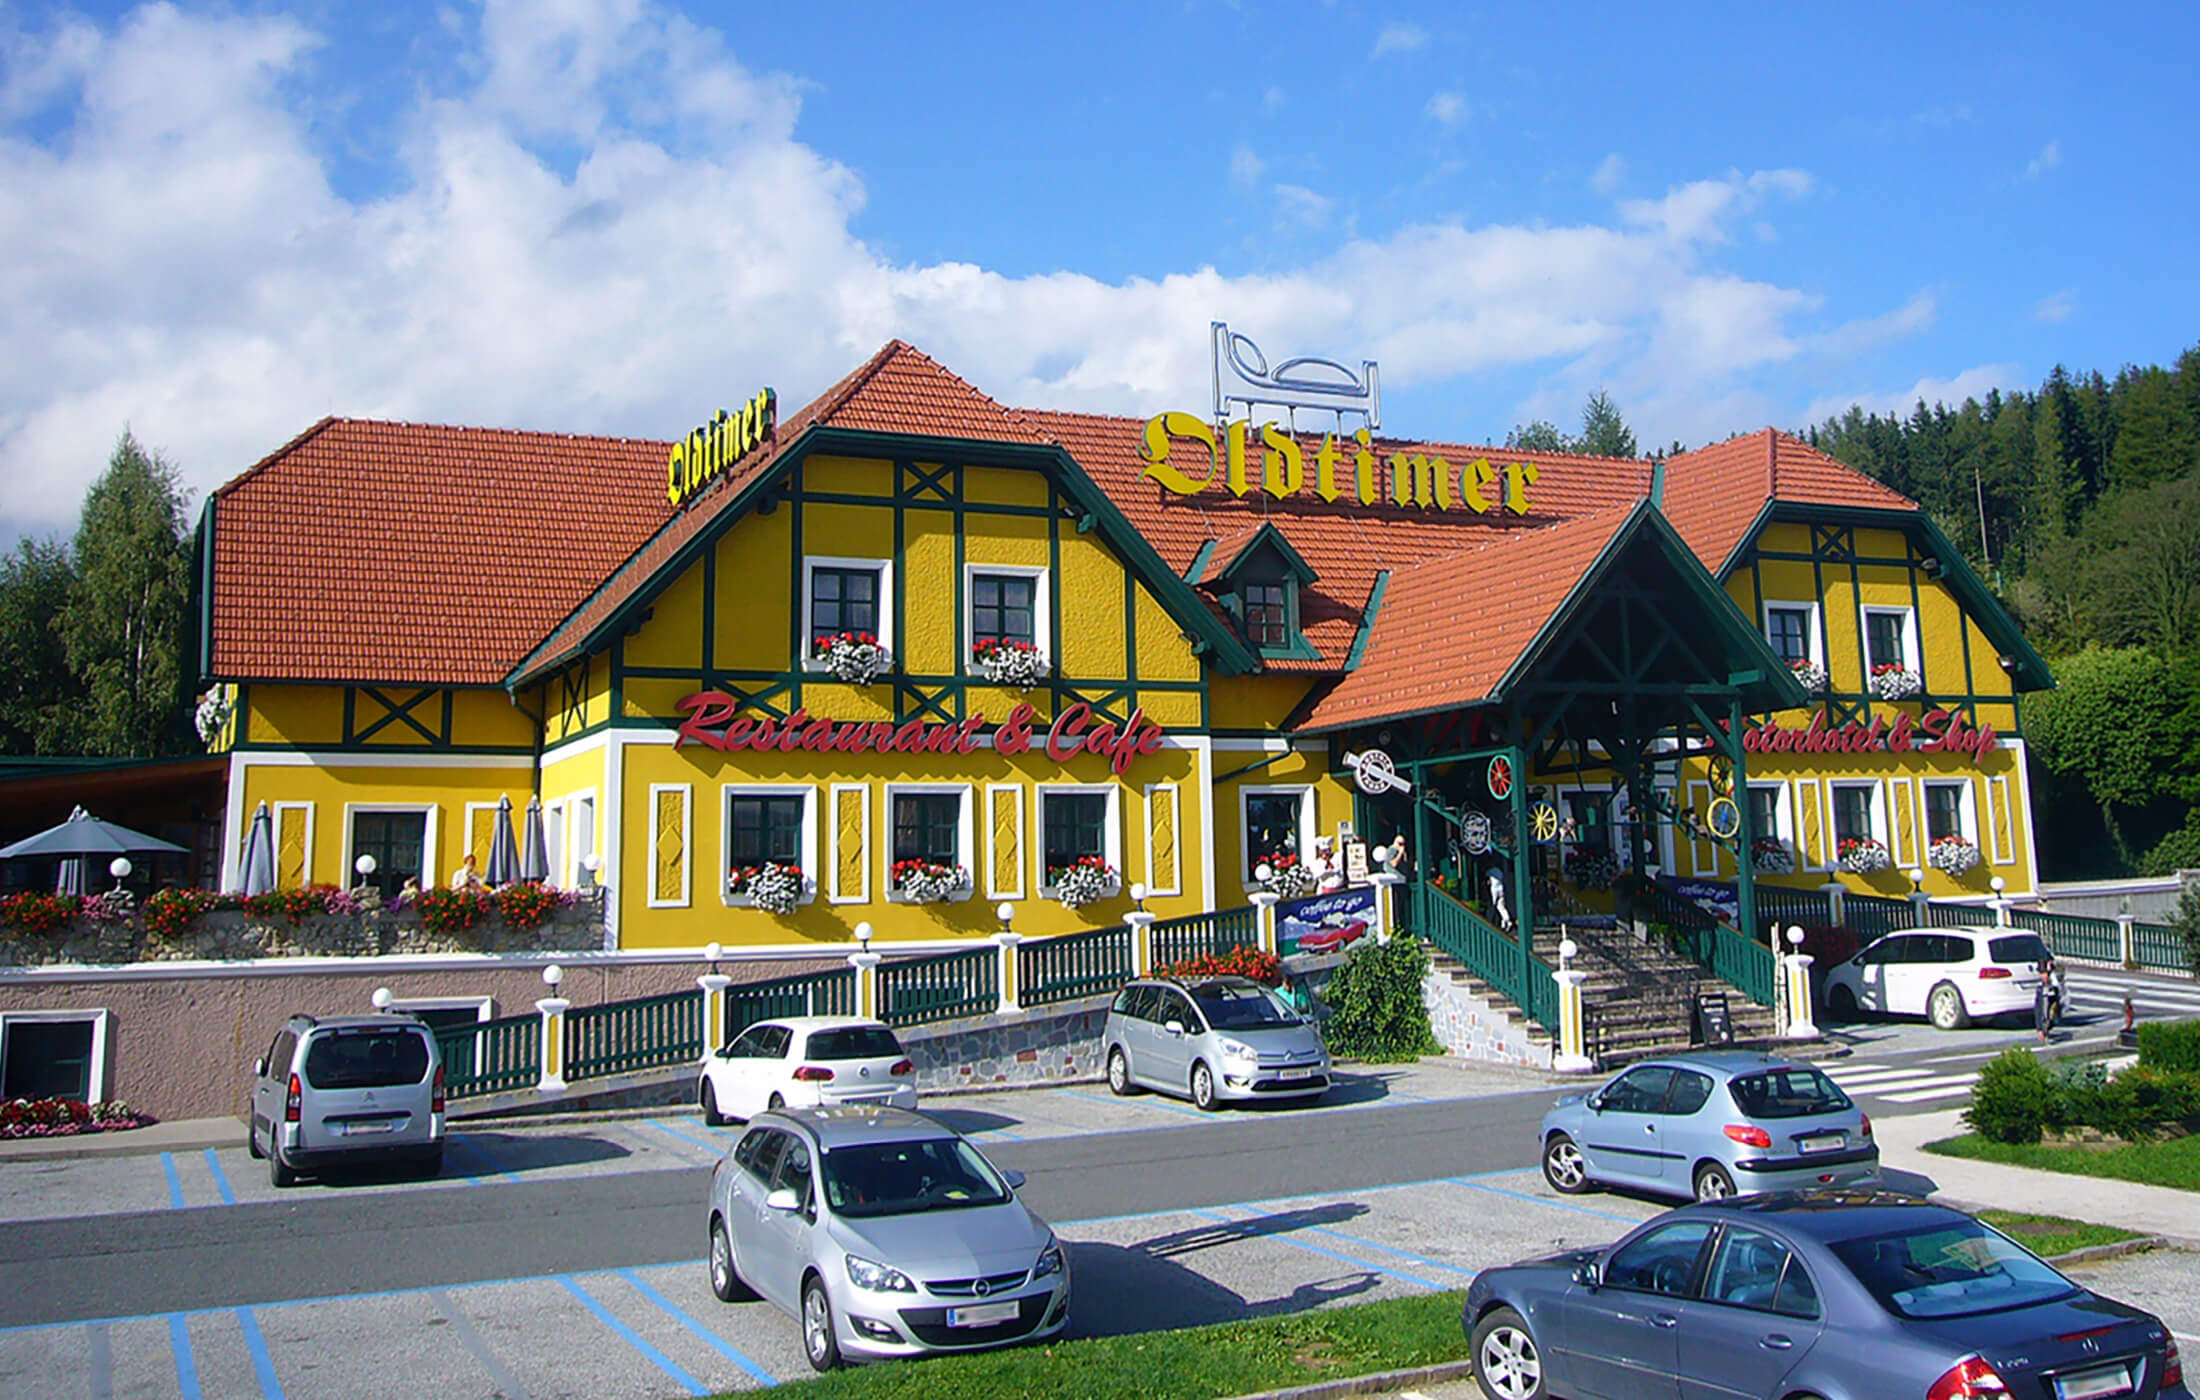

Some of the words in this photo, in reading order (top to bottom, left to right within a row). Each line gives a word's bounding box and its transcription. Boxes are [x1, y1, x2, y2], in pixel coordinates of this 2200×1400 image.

[668, 387, 777, 506] Oldtimer
[1136, 411, 1541, 516] Oldtimer
[673, 691, 985, 754] Restaurant
[994, 703, 1034, 755] &
[1044, 702, 1165, 775] Cafe
[1886, 711, 1914, 753] &
[1920, 709, 1999, 766] Shop
